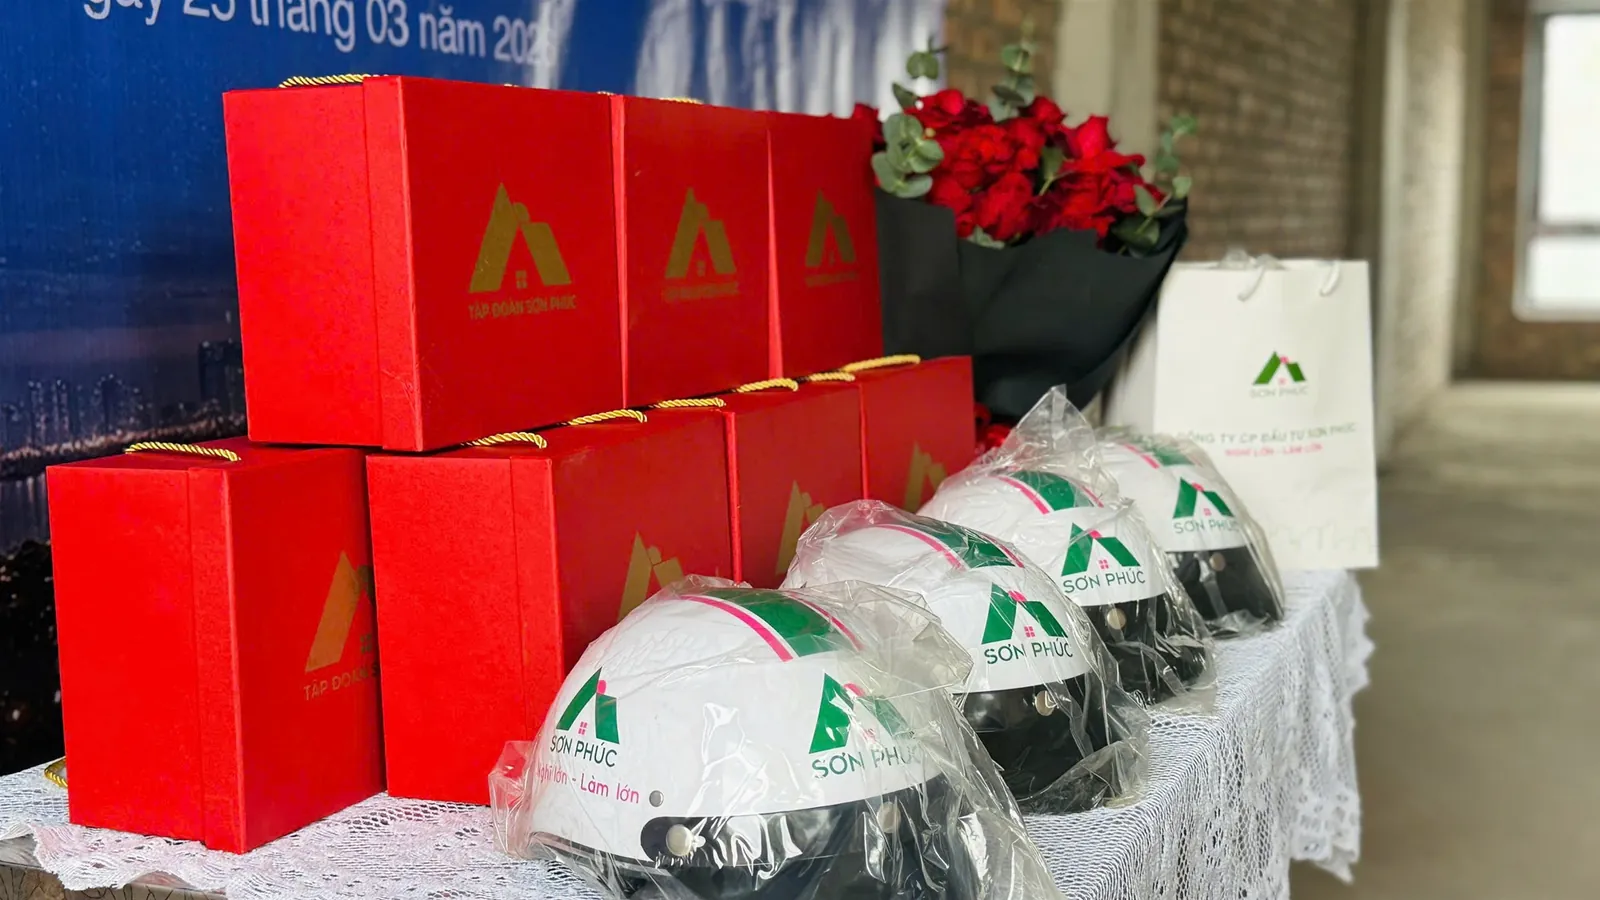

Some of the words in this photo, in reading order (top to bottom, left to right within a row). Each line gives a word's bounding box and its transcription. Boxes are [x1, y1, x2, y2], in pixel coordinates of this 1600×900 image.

[366, 0, 409, 47] 03
[419, 4, 486, 58] năm
[1173, 520, 1204, 534] SƠN
[1063, 575, 1101, 594] SƠN
[1105, 567, 1146, 586] PHÚC
[984, 643, 1027, 665] SƠN
[1031, 637, 1073, 658] PHÚC
[550, 735, 573, 755] SƠN
[574, 741, 618, 768] PHÚC
[811, 751, 866, 779] SƠN
[580, 772, 609, 798] Làm
[615, 783, 640, 804] lớn
